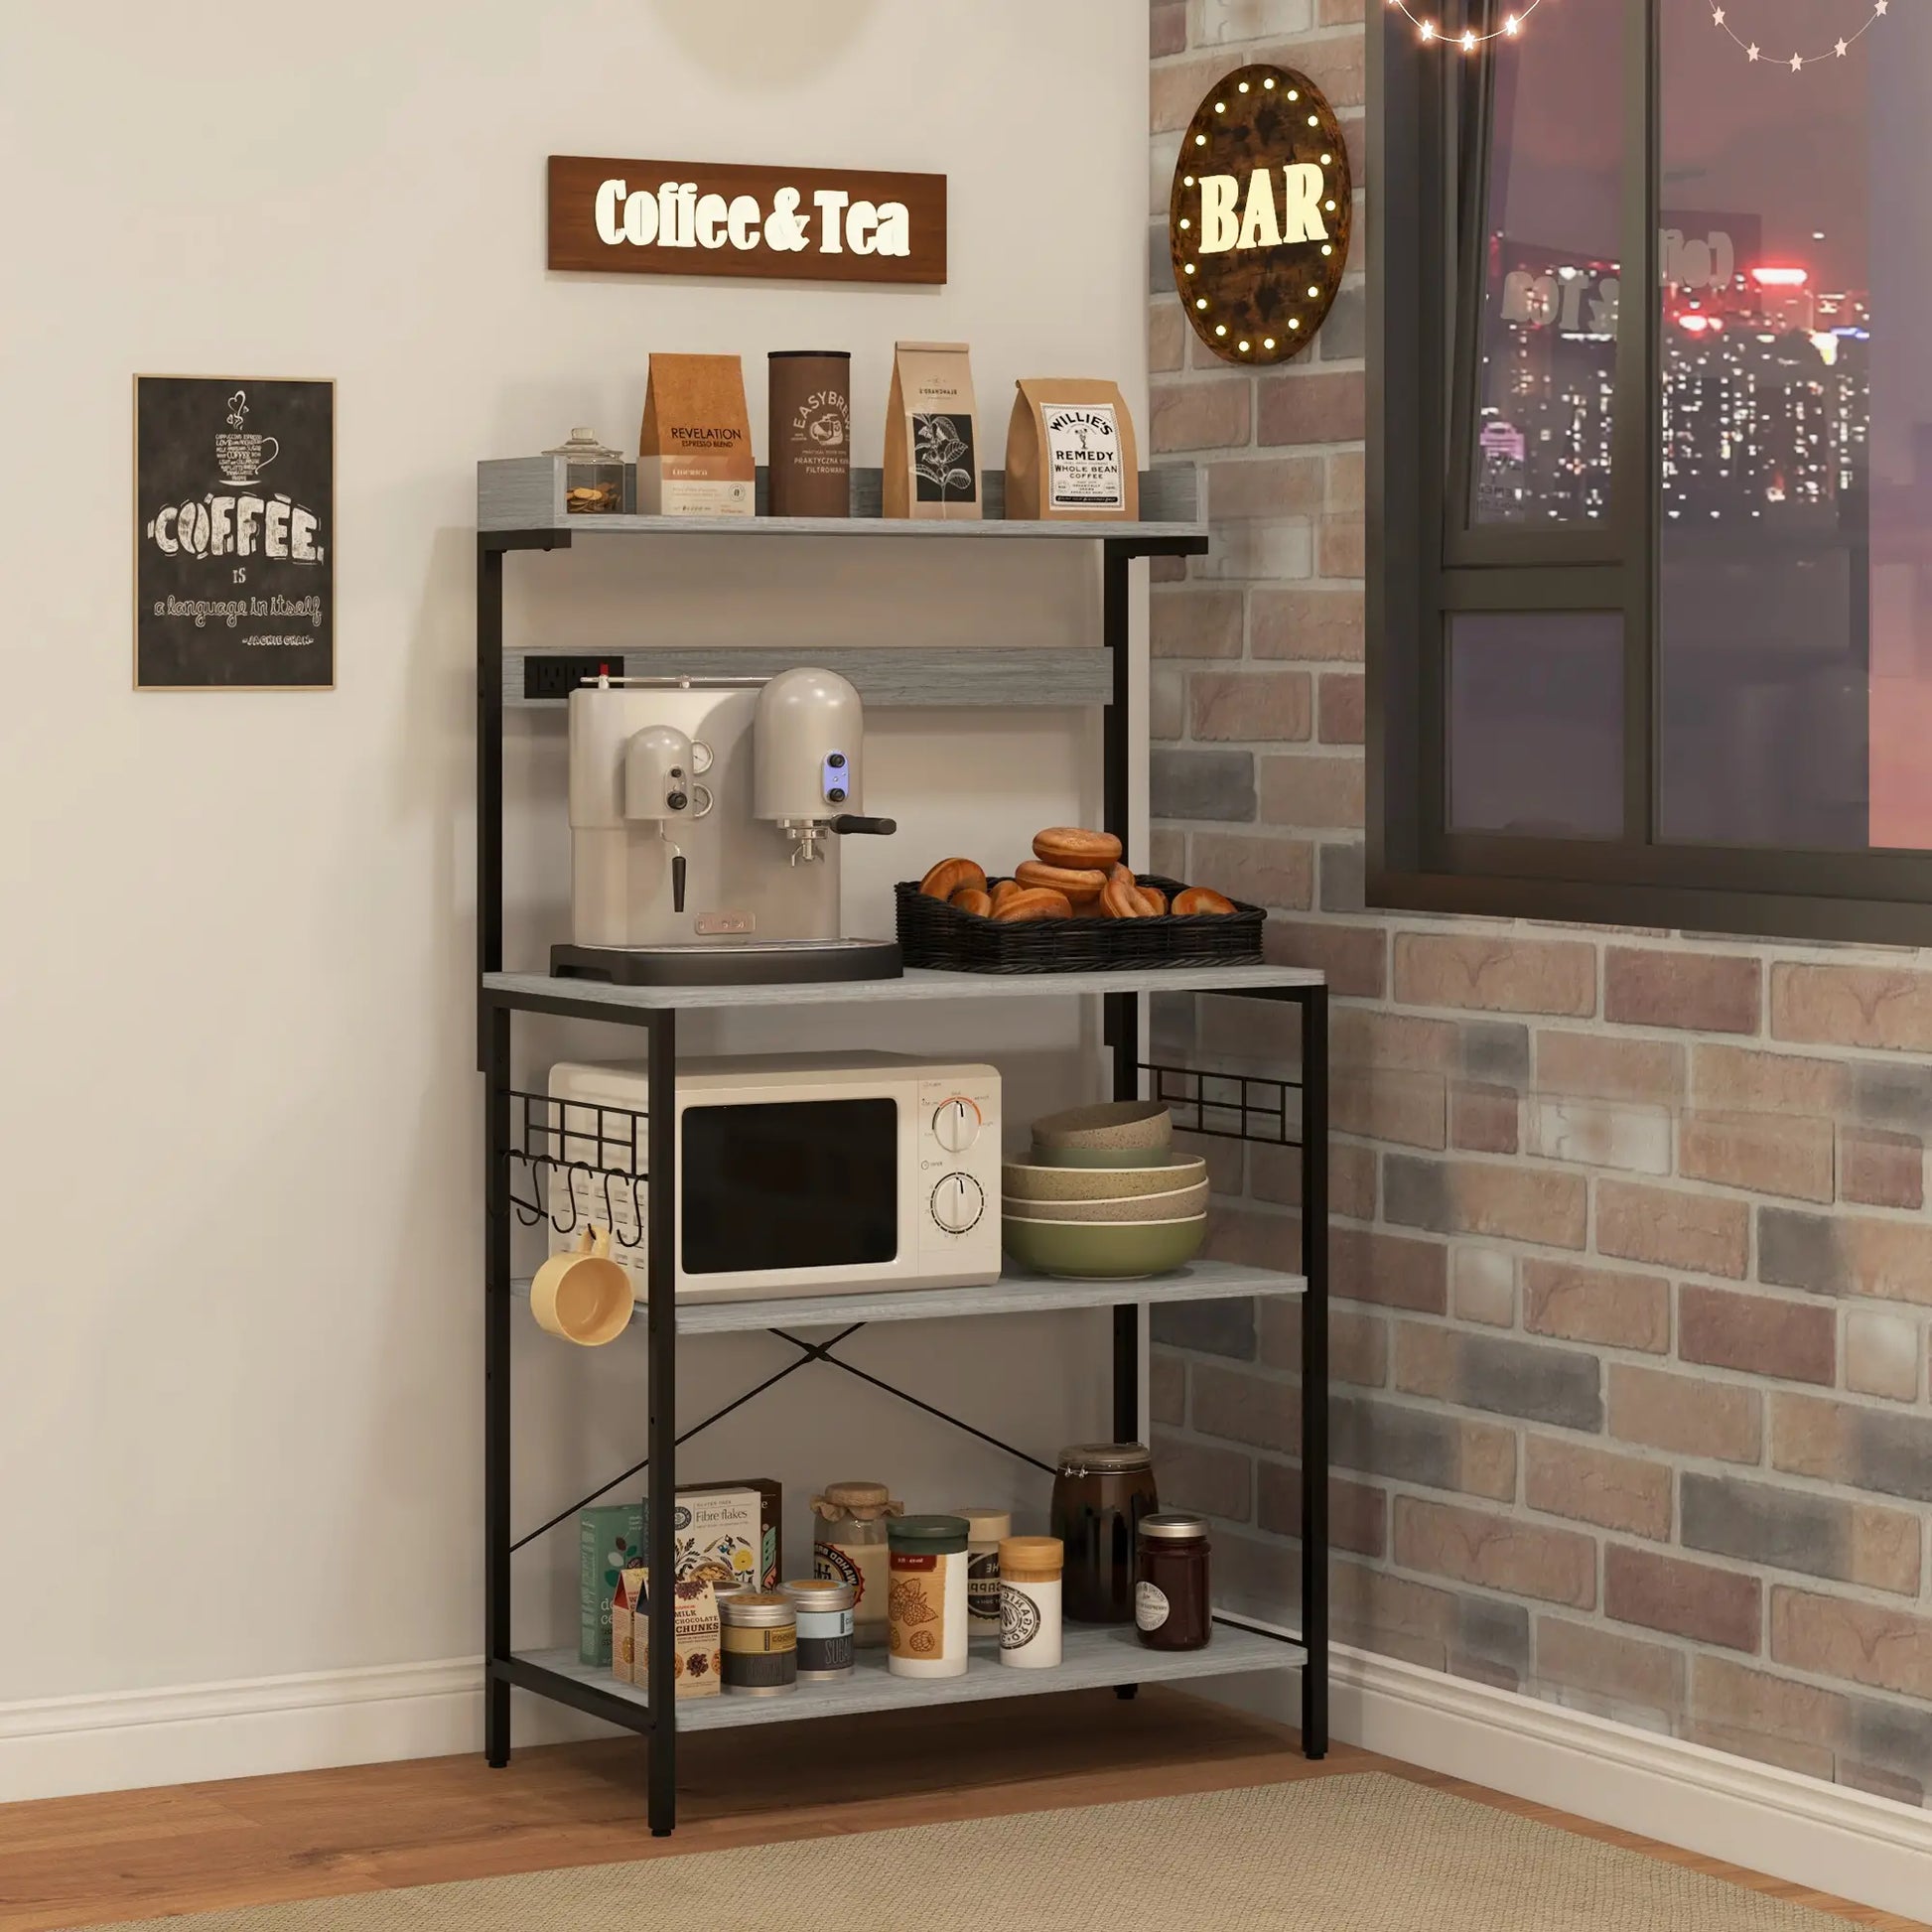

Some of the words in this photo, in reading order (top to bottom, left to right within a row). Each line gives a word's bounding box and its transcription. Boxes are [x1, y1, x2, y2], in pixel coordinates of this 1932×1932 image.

[596, 179, 760, 251] Coffee
[1198, 163, 1329, 254] BAR
[1050, 412, 1114, 436] WILLIE'S
[671, 427, 742, 440] REVELATION
[1055, 451, 1114, 461] REMEDY
[1054, 464, 1088, 473] WHOLE
[154, 495, 319, 561] COFFEE
[232, 567, 247, 584] IS
[154, 600, 166, 617] a
[167, 595, 248, 627] language
[249, 597, 268, 617] in
[269, 595, 323, 626] itself
[696, 1511, 720, 1523] Fibre
[721, 1509, 748, 1520] flakes
[674, 1615, 719, 1625] CHOCOLATE
[675, 1609, 697, 1618] MILK
[675, 1622, 719, 1634] CHUNKS
